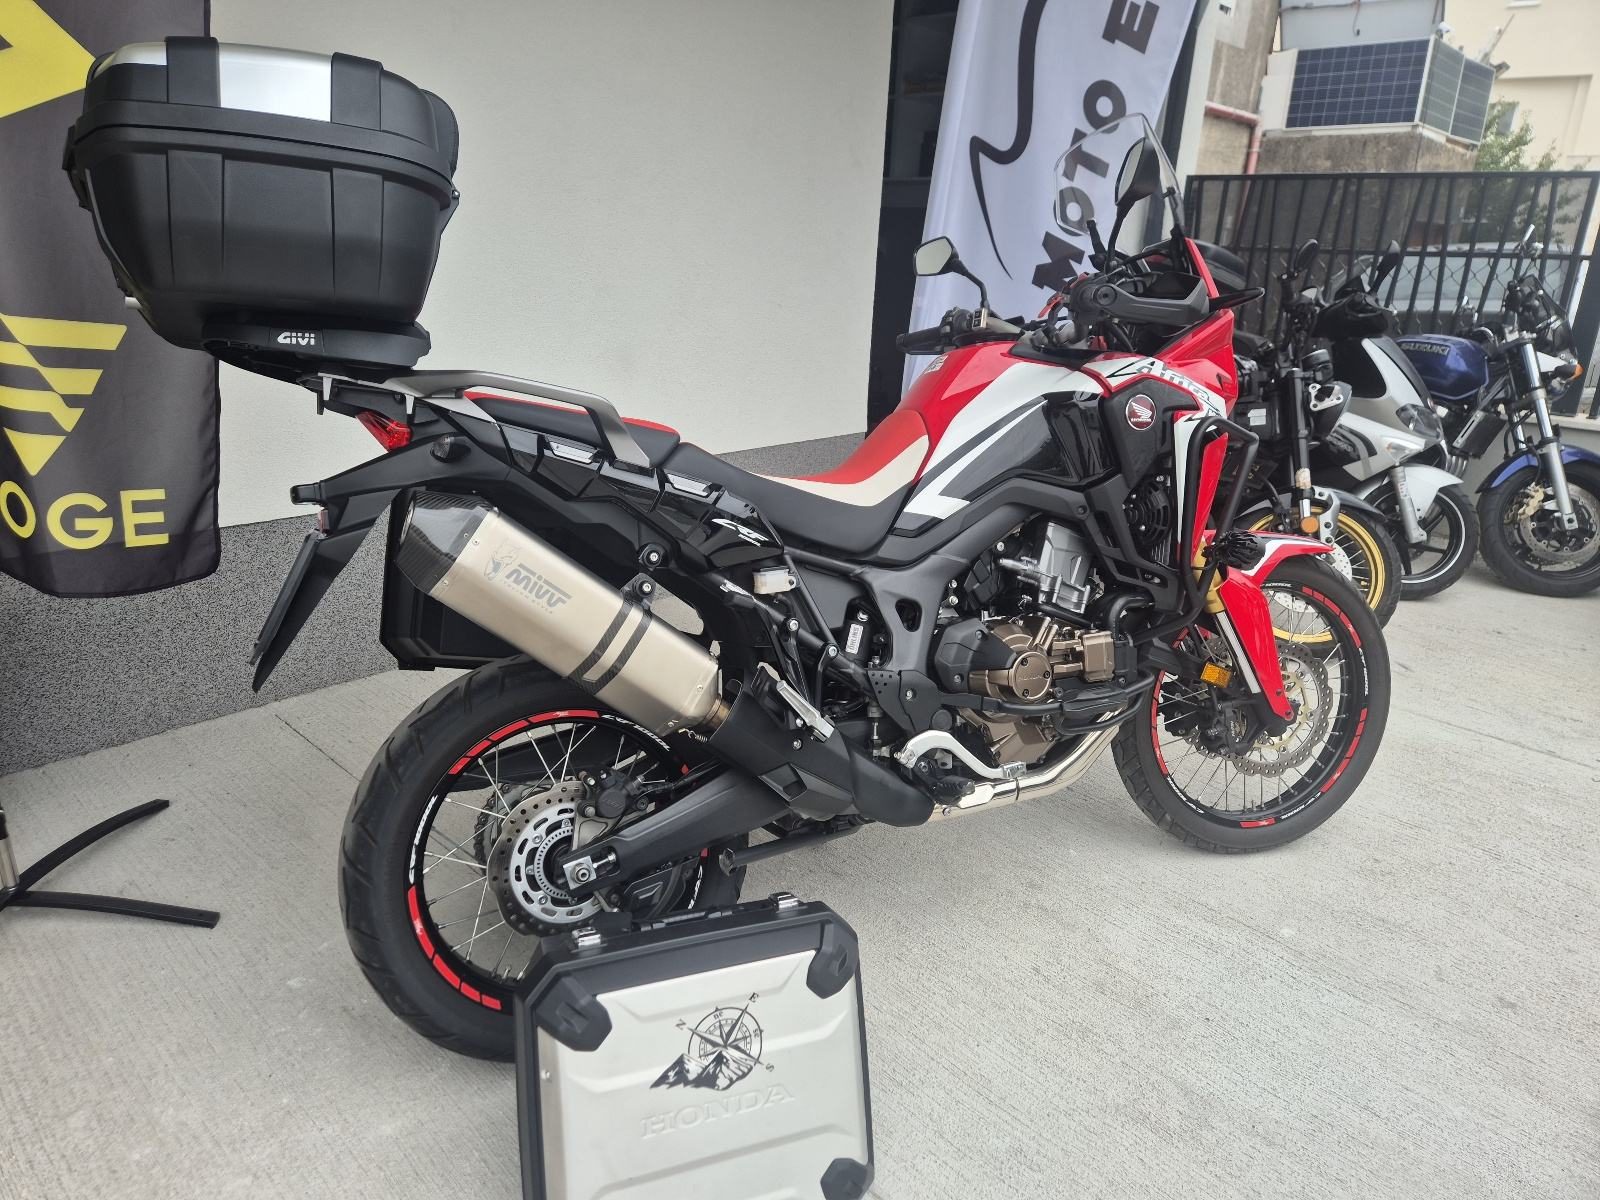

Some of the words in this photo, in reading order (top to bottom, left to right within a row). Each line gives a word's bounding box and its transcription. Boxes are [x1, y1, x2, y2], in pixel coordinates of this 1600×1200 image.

[1031, 79, 1127, 292] MOTO
[1400, 342, 1450, 356] SUZUKI
[639, 1083, 796, 1140] HONDA
